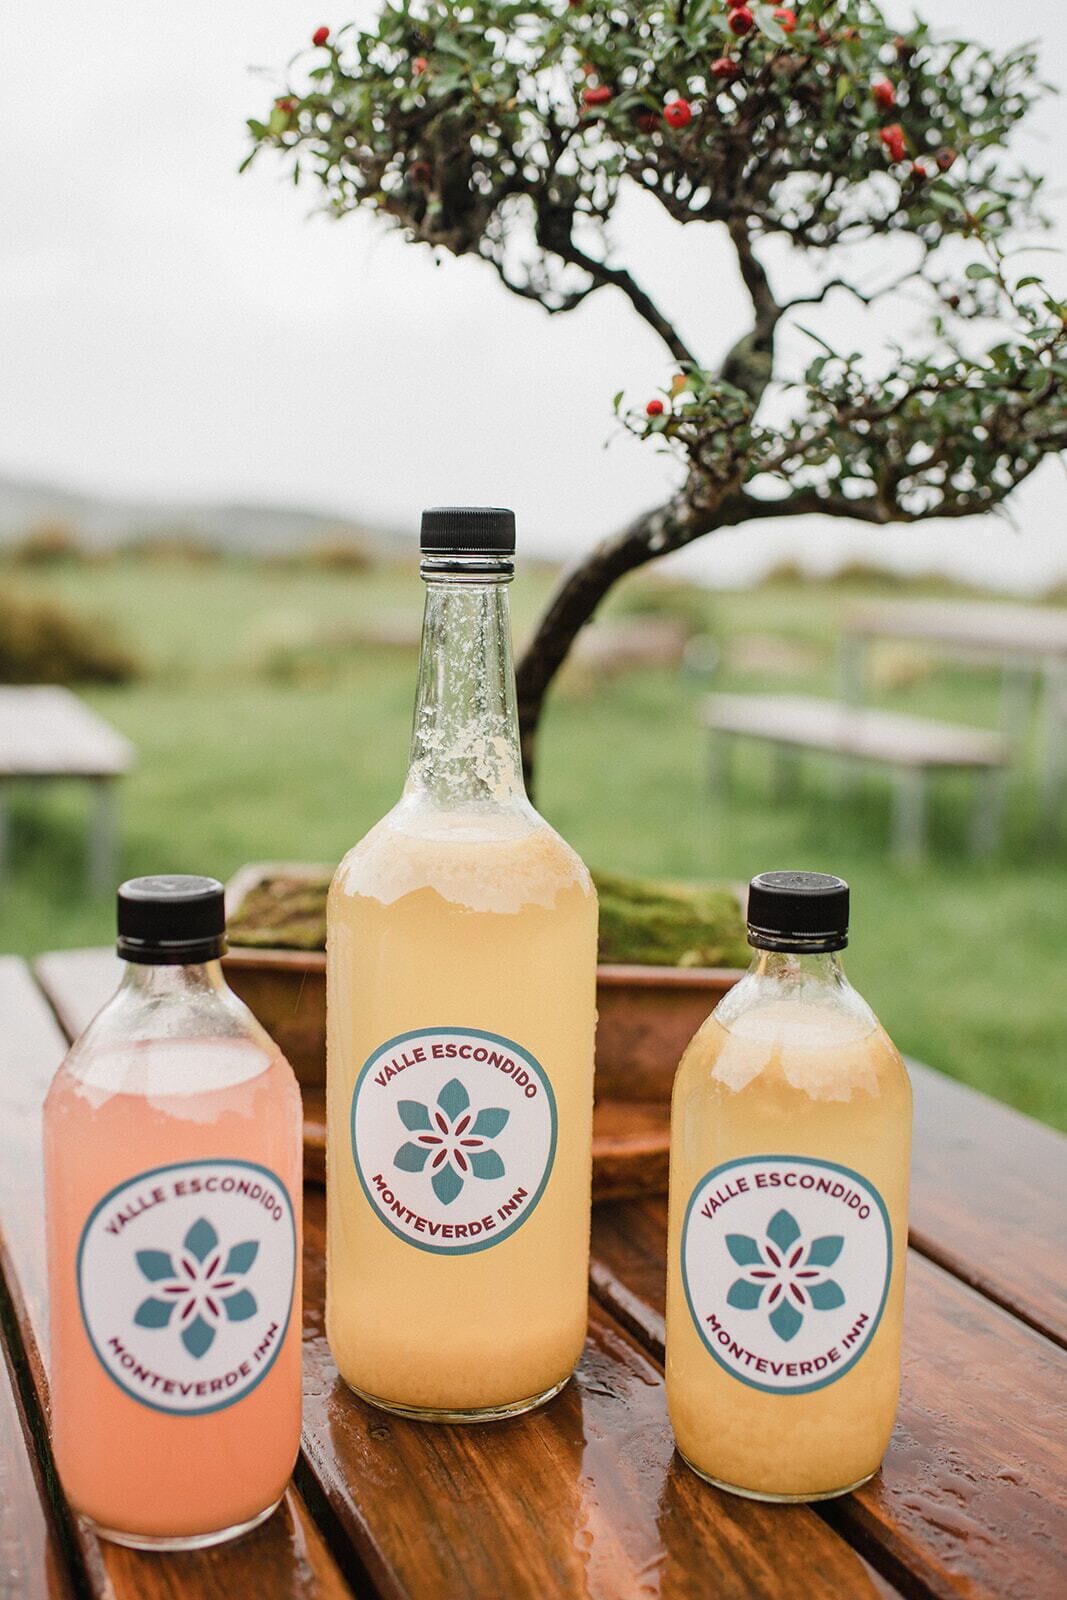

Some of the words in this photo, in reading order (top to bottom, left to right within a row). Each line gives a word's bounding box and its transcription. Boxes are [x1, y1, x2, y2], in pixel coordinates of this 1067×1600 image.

[373, 1047, 428, 1087] VALLE
[431, 1043, 538, 1099] ESCONDIDO
[105, 1187, 167, 1235] VALLE
[173, 1176, 283, 1222] ESCONDIDO
[372, 1174, 497, 1239] MONTEVERDE
[497, 1186, 529, 1221] INN
[700, 1176, 750, 1220] VALLE
[754, 1172, 871, 1220] ESCONDIDO
[108, 1337, 252, 1396] MONTEVERDE
[253, 1321, 280, 1362] INN
[706, 1313, 842, 1377] MONTEVERDE
[841, 1312, 870, 1350] INN
